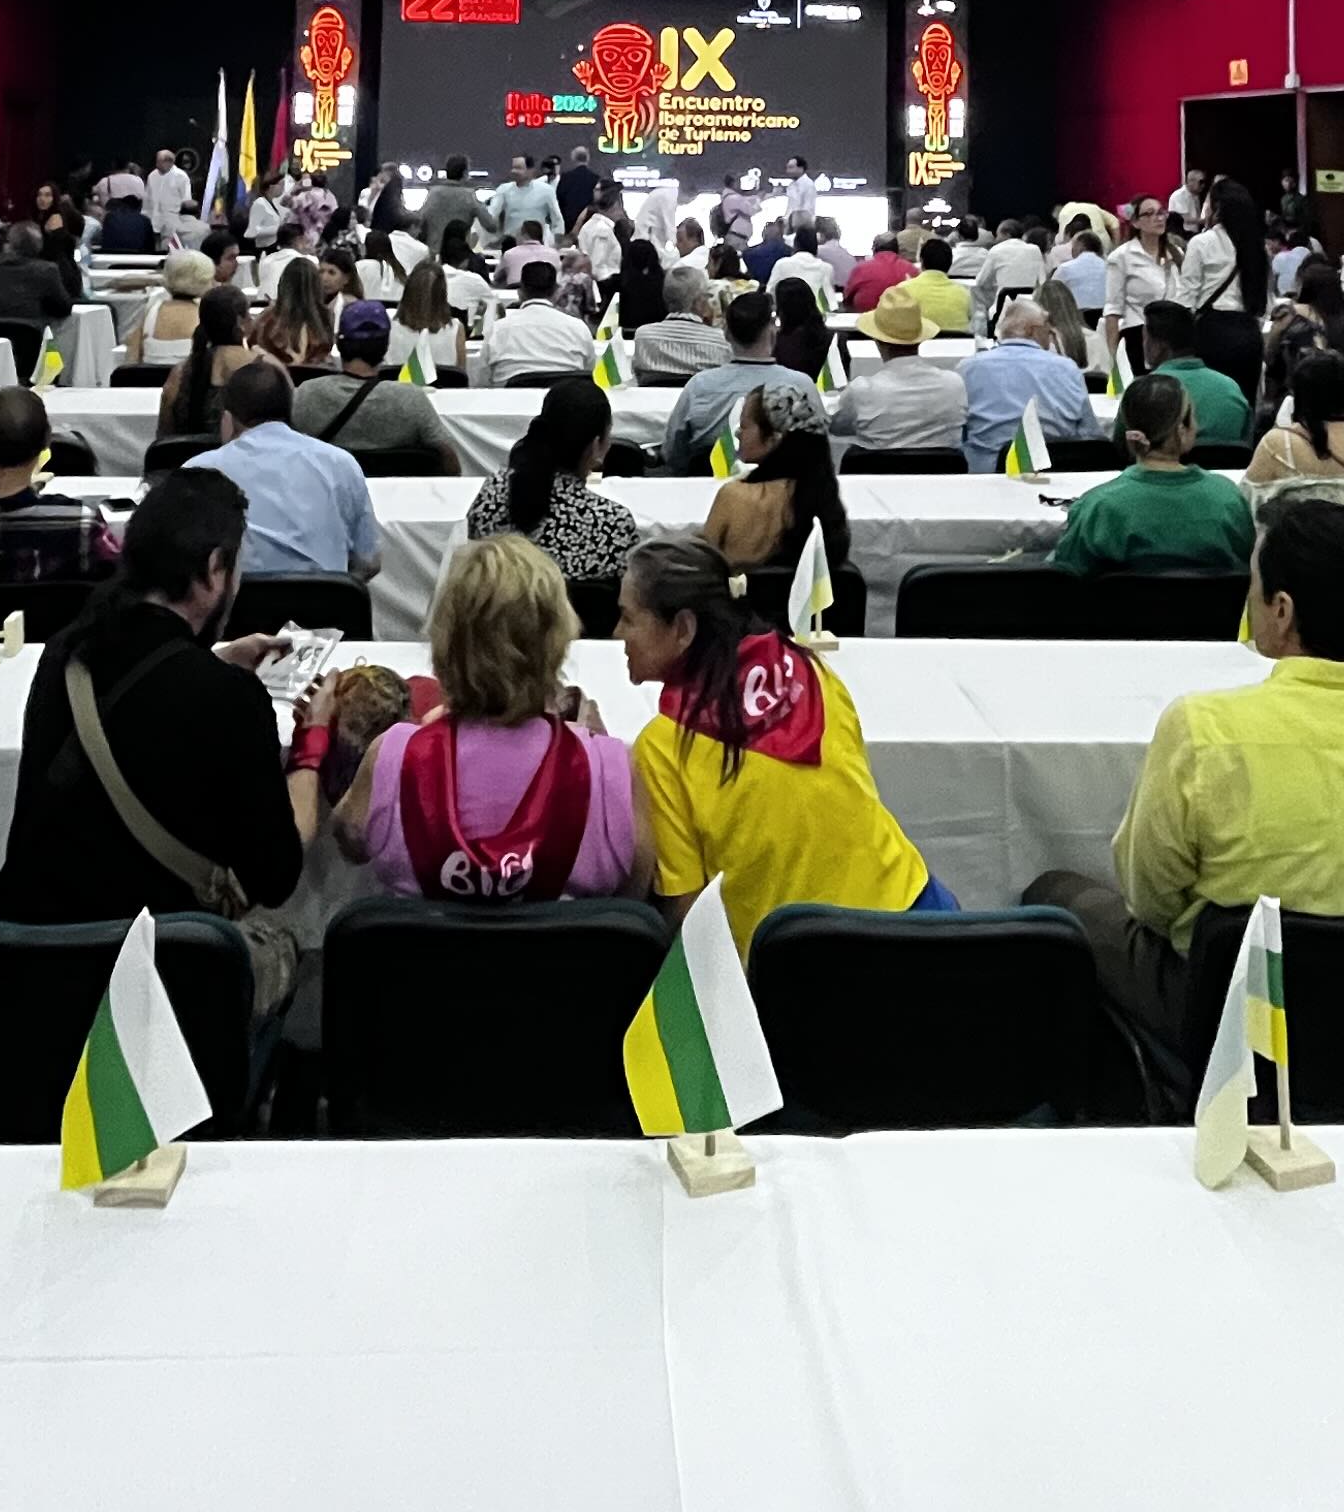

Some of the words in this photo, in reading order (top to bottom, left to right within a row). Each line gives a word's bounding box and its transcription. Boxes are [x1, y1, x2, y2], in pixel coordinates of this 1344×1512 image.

[660, 26, 737, 92] IX
[552, 94, 597, 112] 2024
[658, 92, 766, 112] Encuentro
[658, 110, 801, 129] Iberoamericano
[658, 127, 680, 141] de
[683, 126, 753, 143] Turismo
[658, 140, 704, 156] Rural
